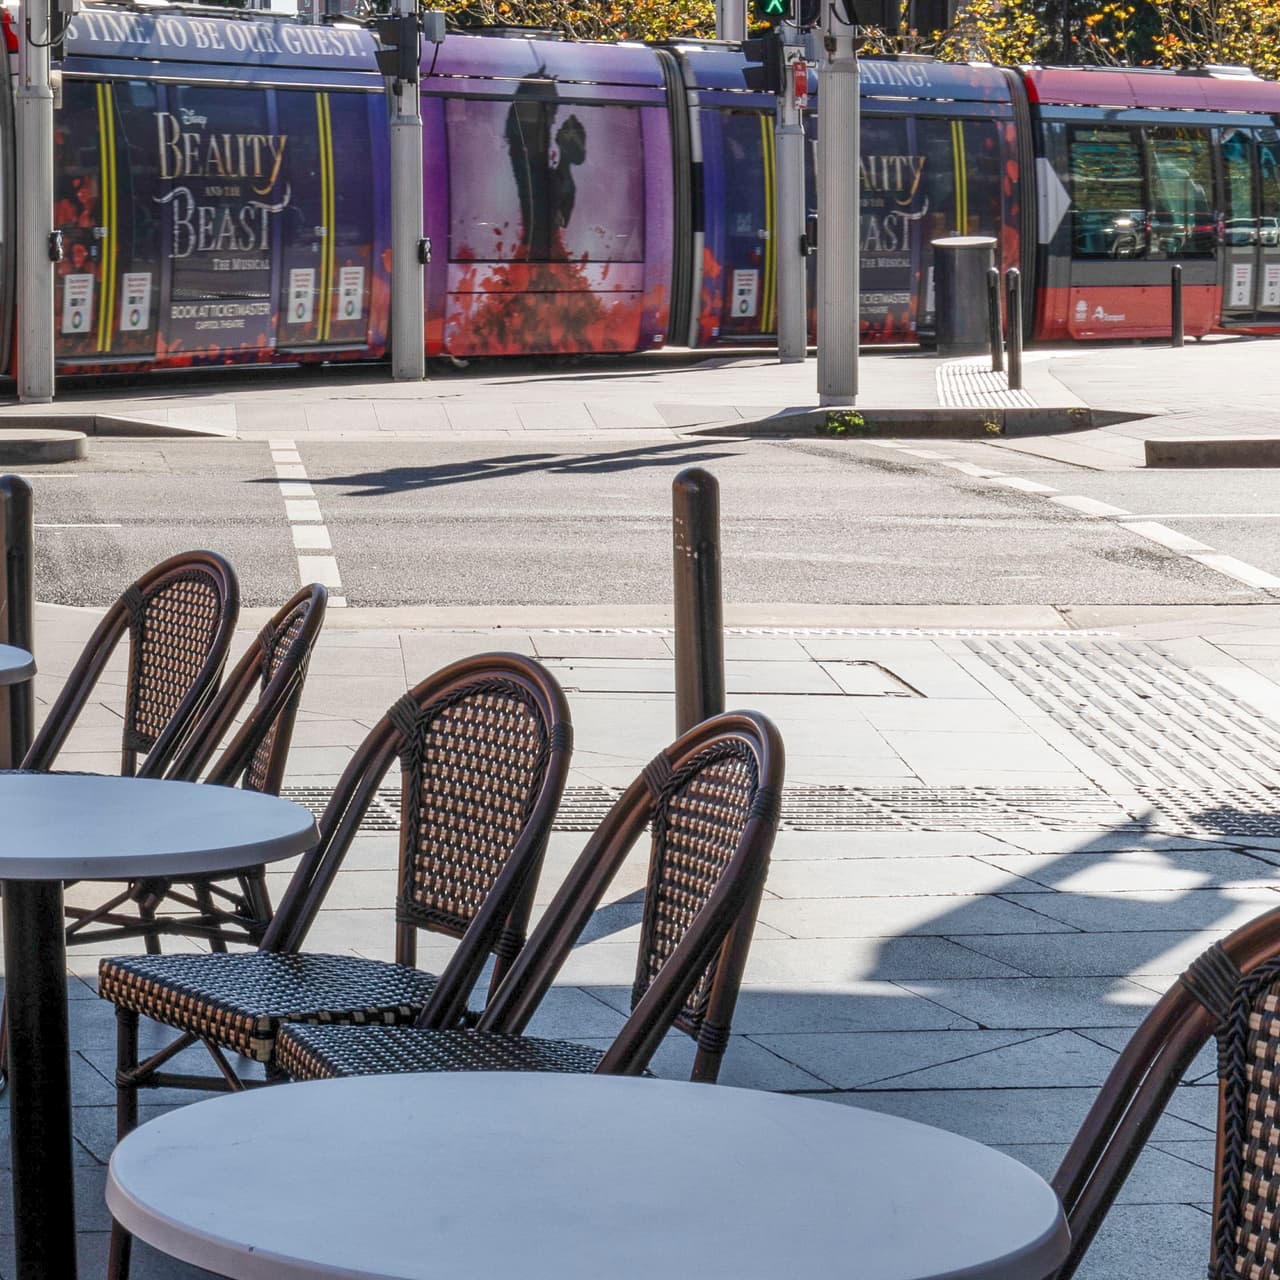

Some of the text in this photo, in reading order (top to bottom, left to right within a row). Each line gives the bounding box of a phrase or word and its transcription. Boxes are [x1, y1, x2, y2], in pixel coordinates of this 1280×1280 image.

[83, 13, 151, 44] TIME
[153, 19, 188, 48] TO
[191, 20, 225, 50] BE
[226, 22, 281, 54] OUR
[281, 26, 368, 57] GUEST!
[153, 111, 289, 196] BEAUTY
[859, 154, 926, 206] AUTY
[152, 184, 290, 258] BEAST
[859, 196, 929, 252] AST
